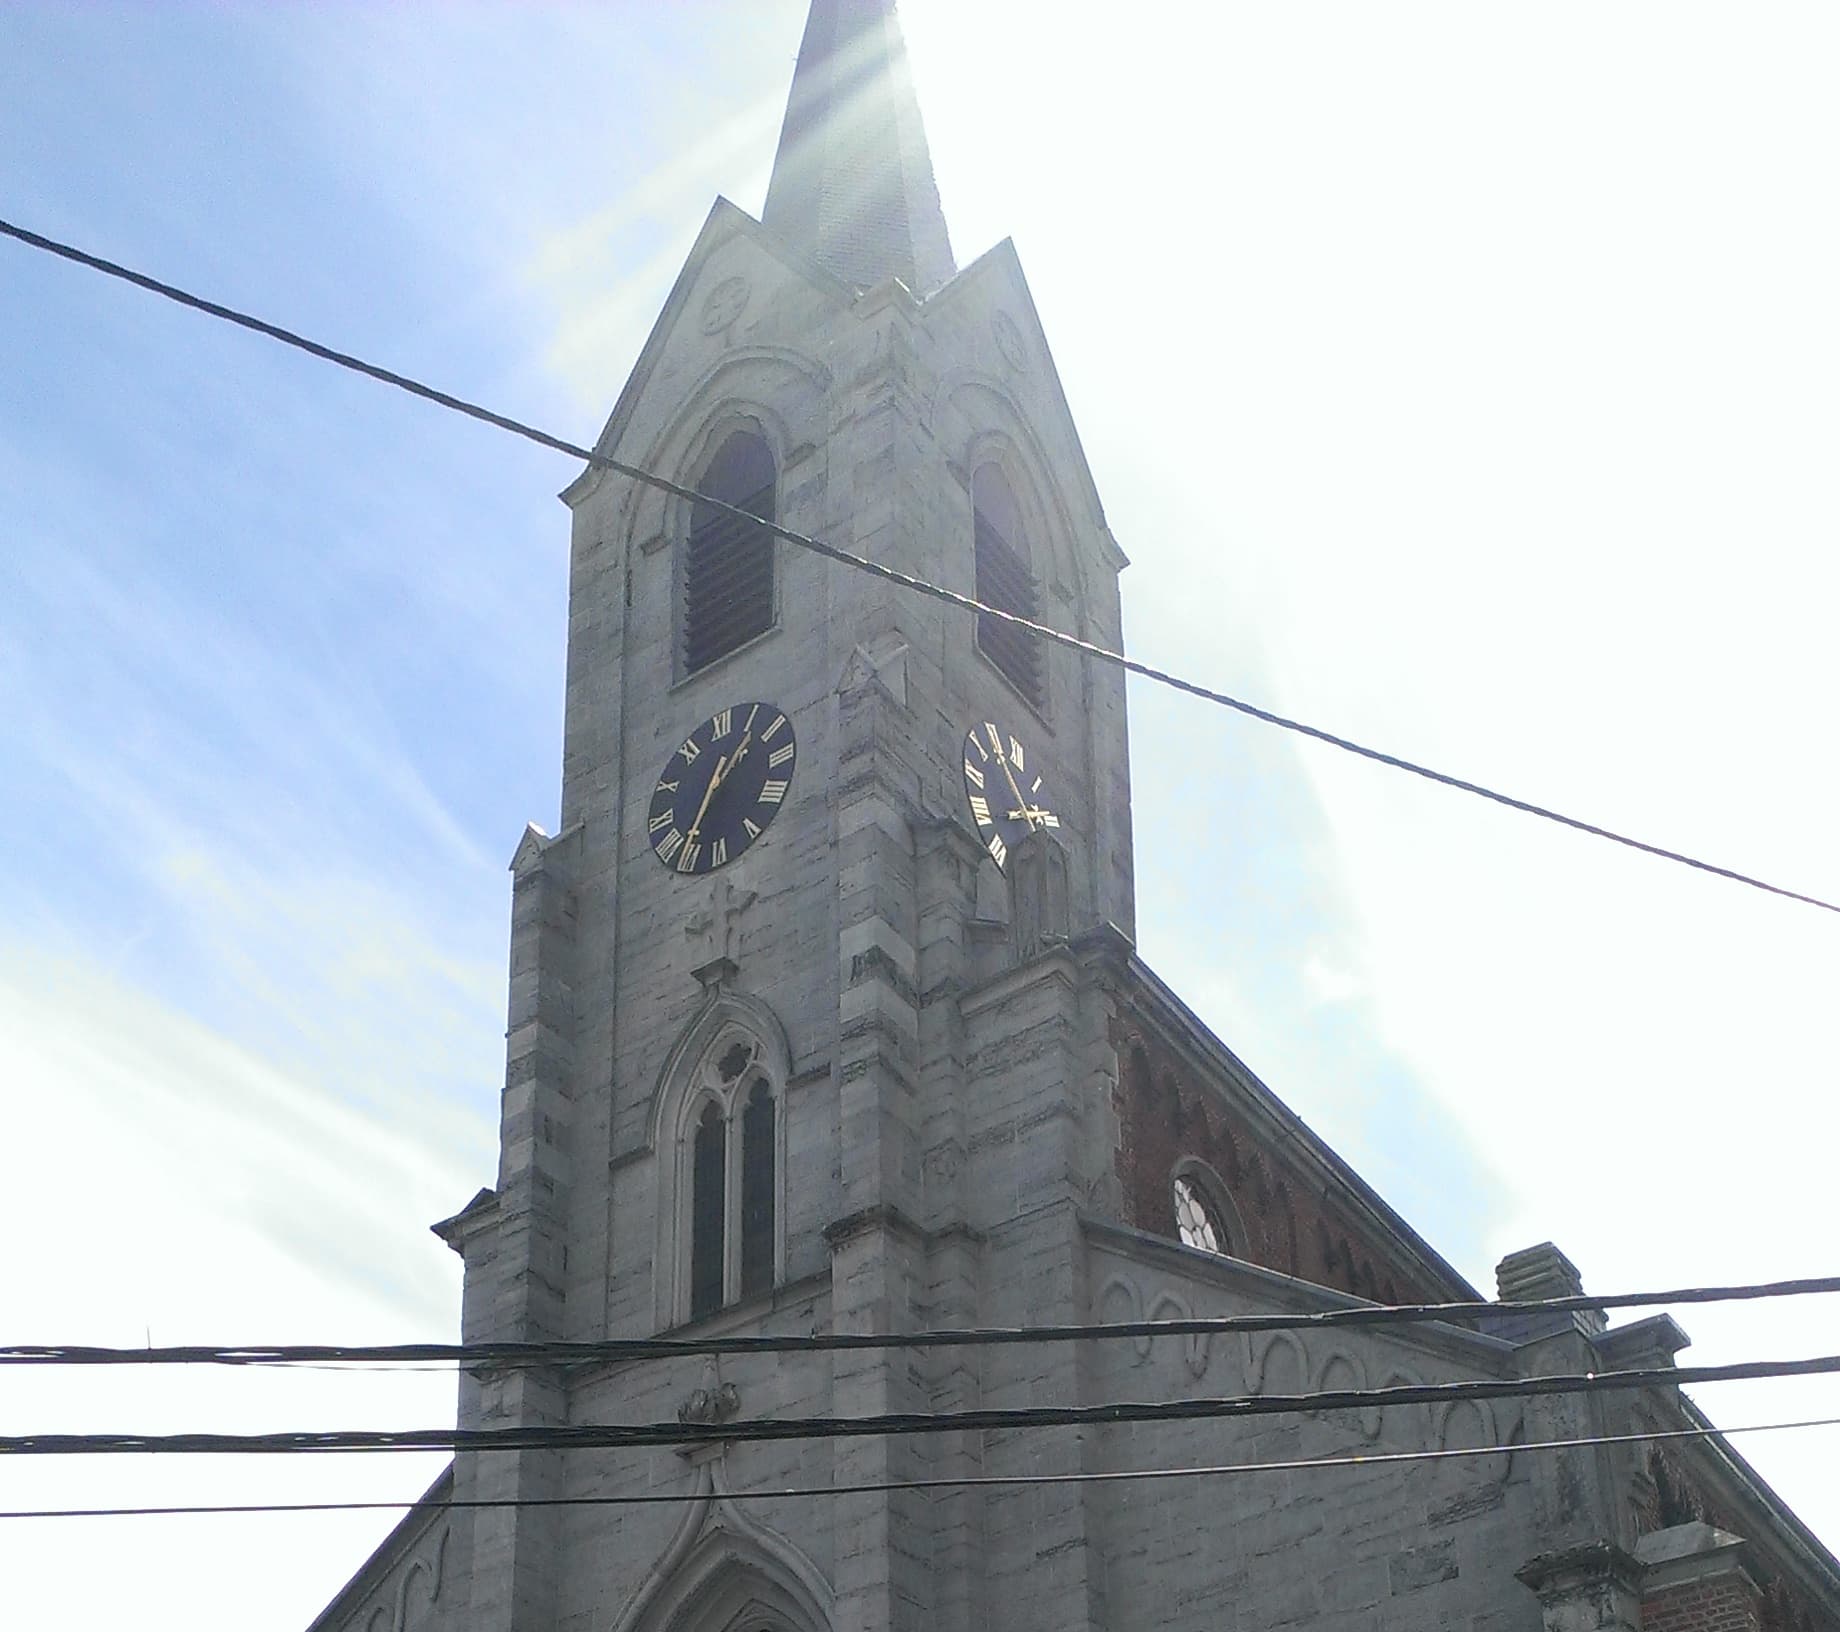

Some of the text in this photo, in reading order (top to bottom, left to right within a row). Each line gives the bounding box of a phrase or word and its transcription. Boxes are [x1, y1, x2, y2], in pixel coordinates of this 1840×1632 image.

[711, 709, 732, 742] XII
[744, 705, 758, 732] I
[762, 715, 785, 741] II
[677, 739, 701, 766] XI
[769, 743, 794, 768] III
[657, 780, 680, 793] X
[758, 780, 788, 803] IIII
[743, 818, 762, 839] V
[676, 843, 701, 872] VI
[712, 837, 727, 867] VI
